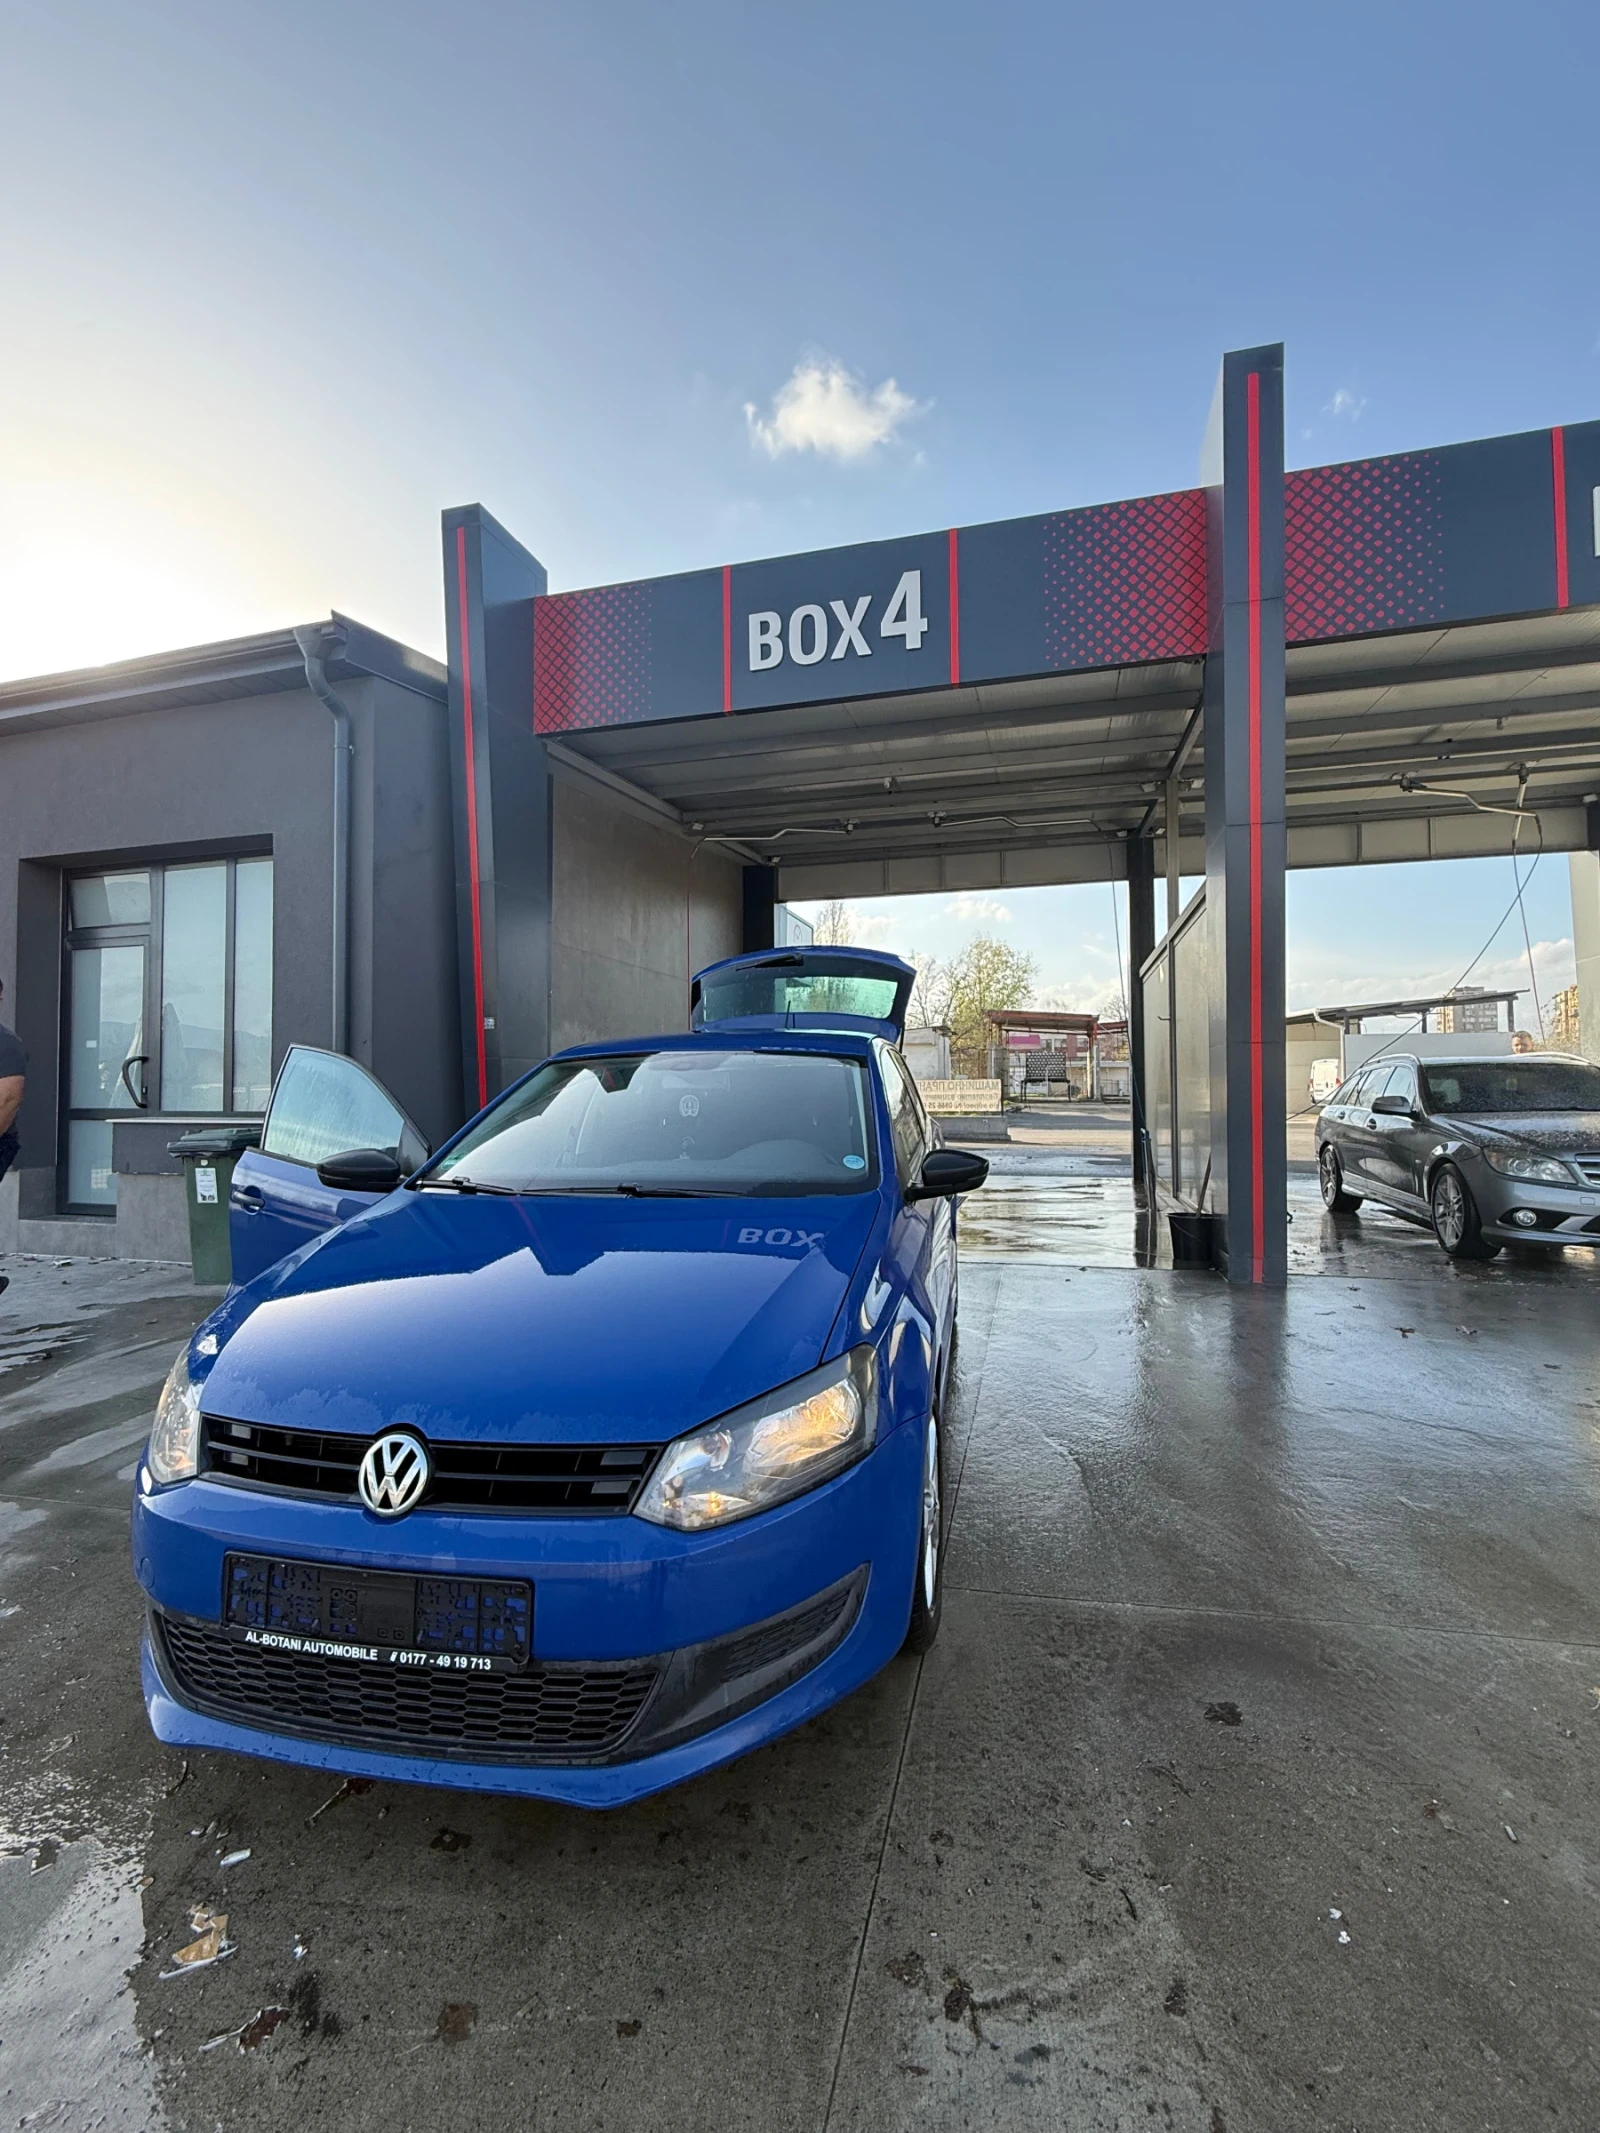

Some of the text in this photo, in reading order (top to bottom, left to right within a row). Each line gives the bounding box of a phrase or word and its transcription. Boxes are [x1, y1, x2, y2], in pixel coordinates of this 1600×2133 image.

[748, 569, 928, 672] BOX 4
[360, 1435, 427, 1515] VW
[245, 1631, 301, 1650] AL-BOTANI
[303, 1641, 378, 1660] AUTOMOBILE
[400, 1652, 427, 1665] 0177
[436, 1655, 451, 1667] 49
[454, 1657, 467, 1668] 19
[470, 1658, 491, 1670] 713
